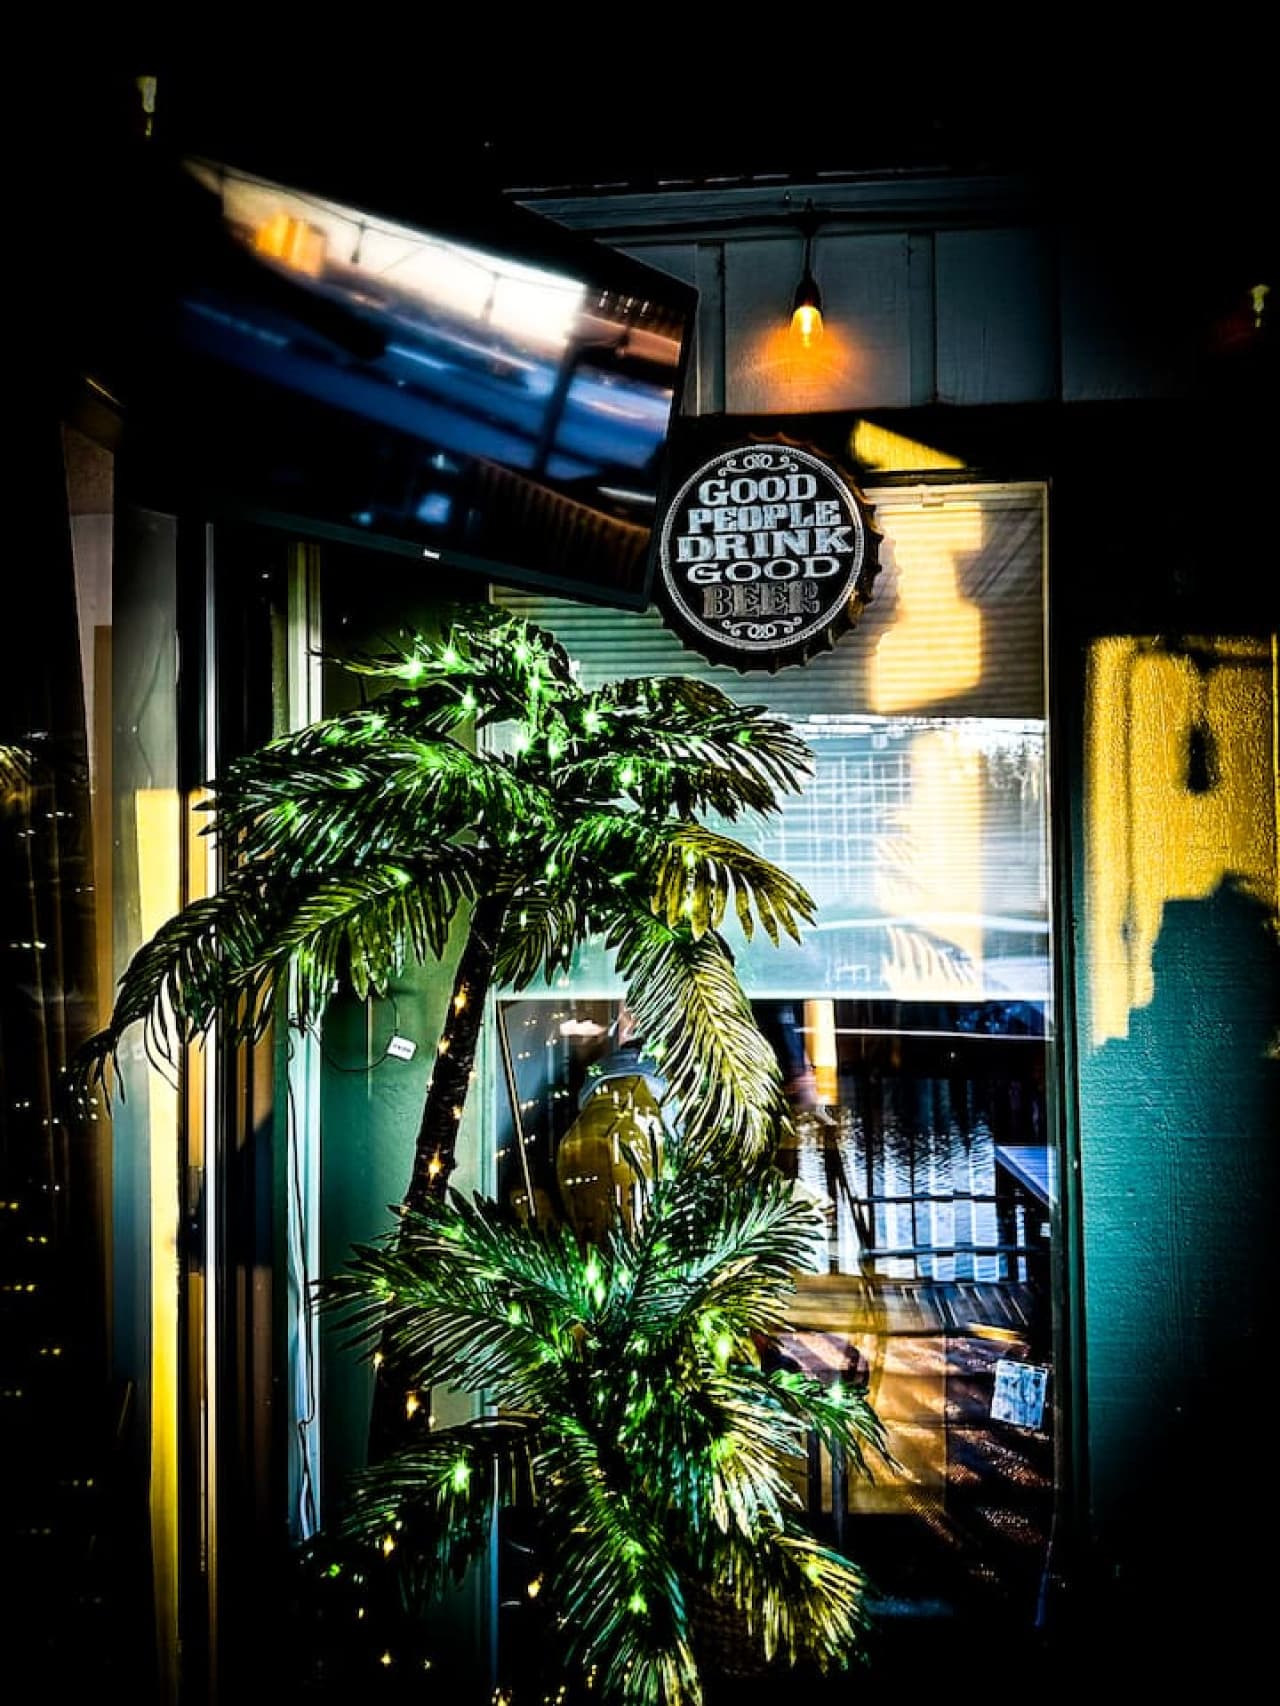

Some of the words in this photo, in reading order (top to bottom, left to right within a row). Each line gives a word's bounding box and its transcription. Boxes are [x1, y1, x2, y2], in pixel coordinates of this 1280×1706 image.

[699, 474, 817, 506] GOOD
[688, 500, 841, 534] PEOPLE
[676, 526, 853, 563] DRINK
[687, 556, 840, 583] GOOD
[702, 580, 820, 619] BEER
